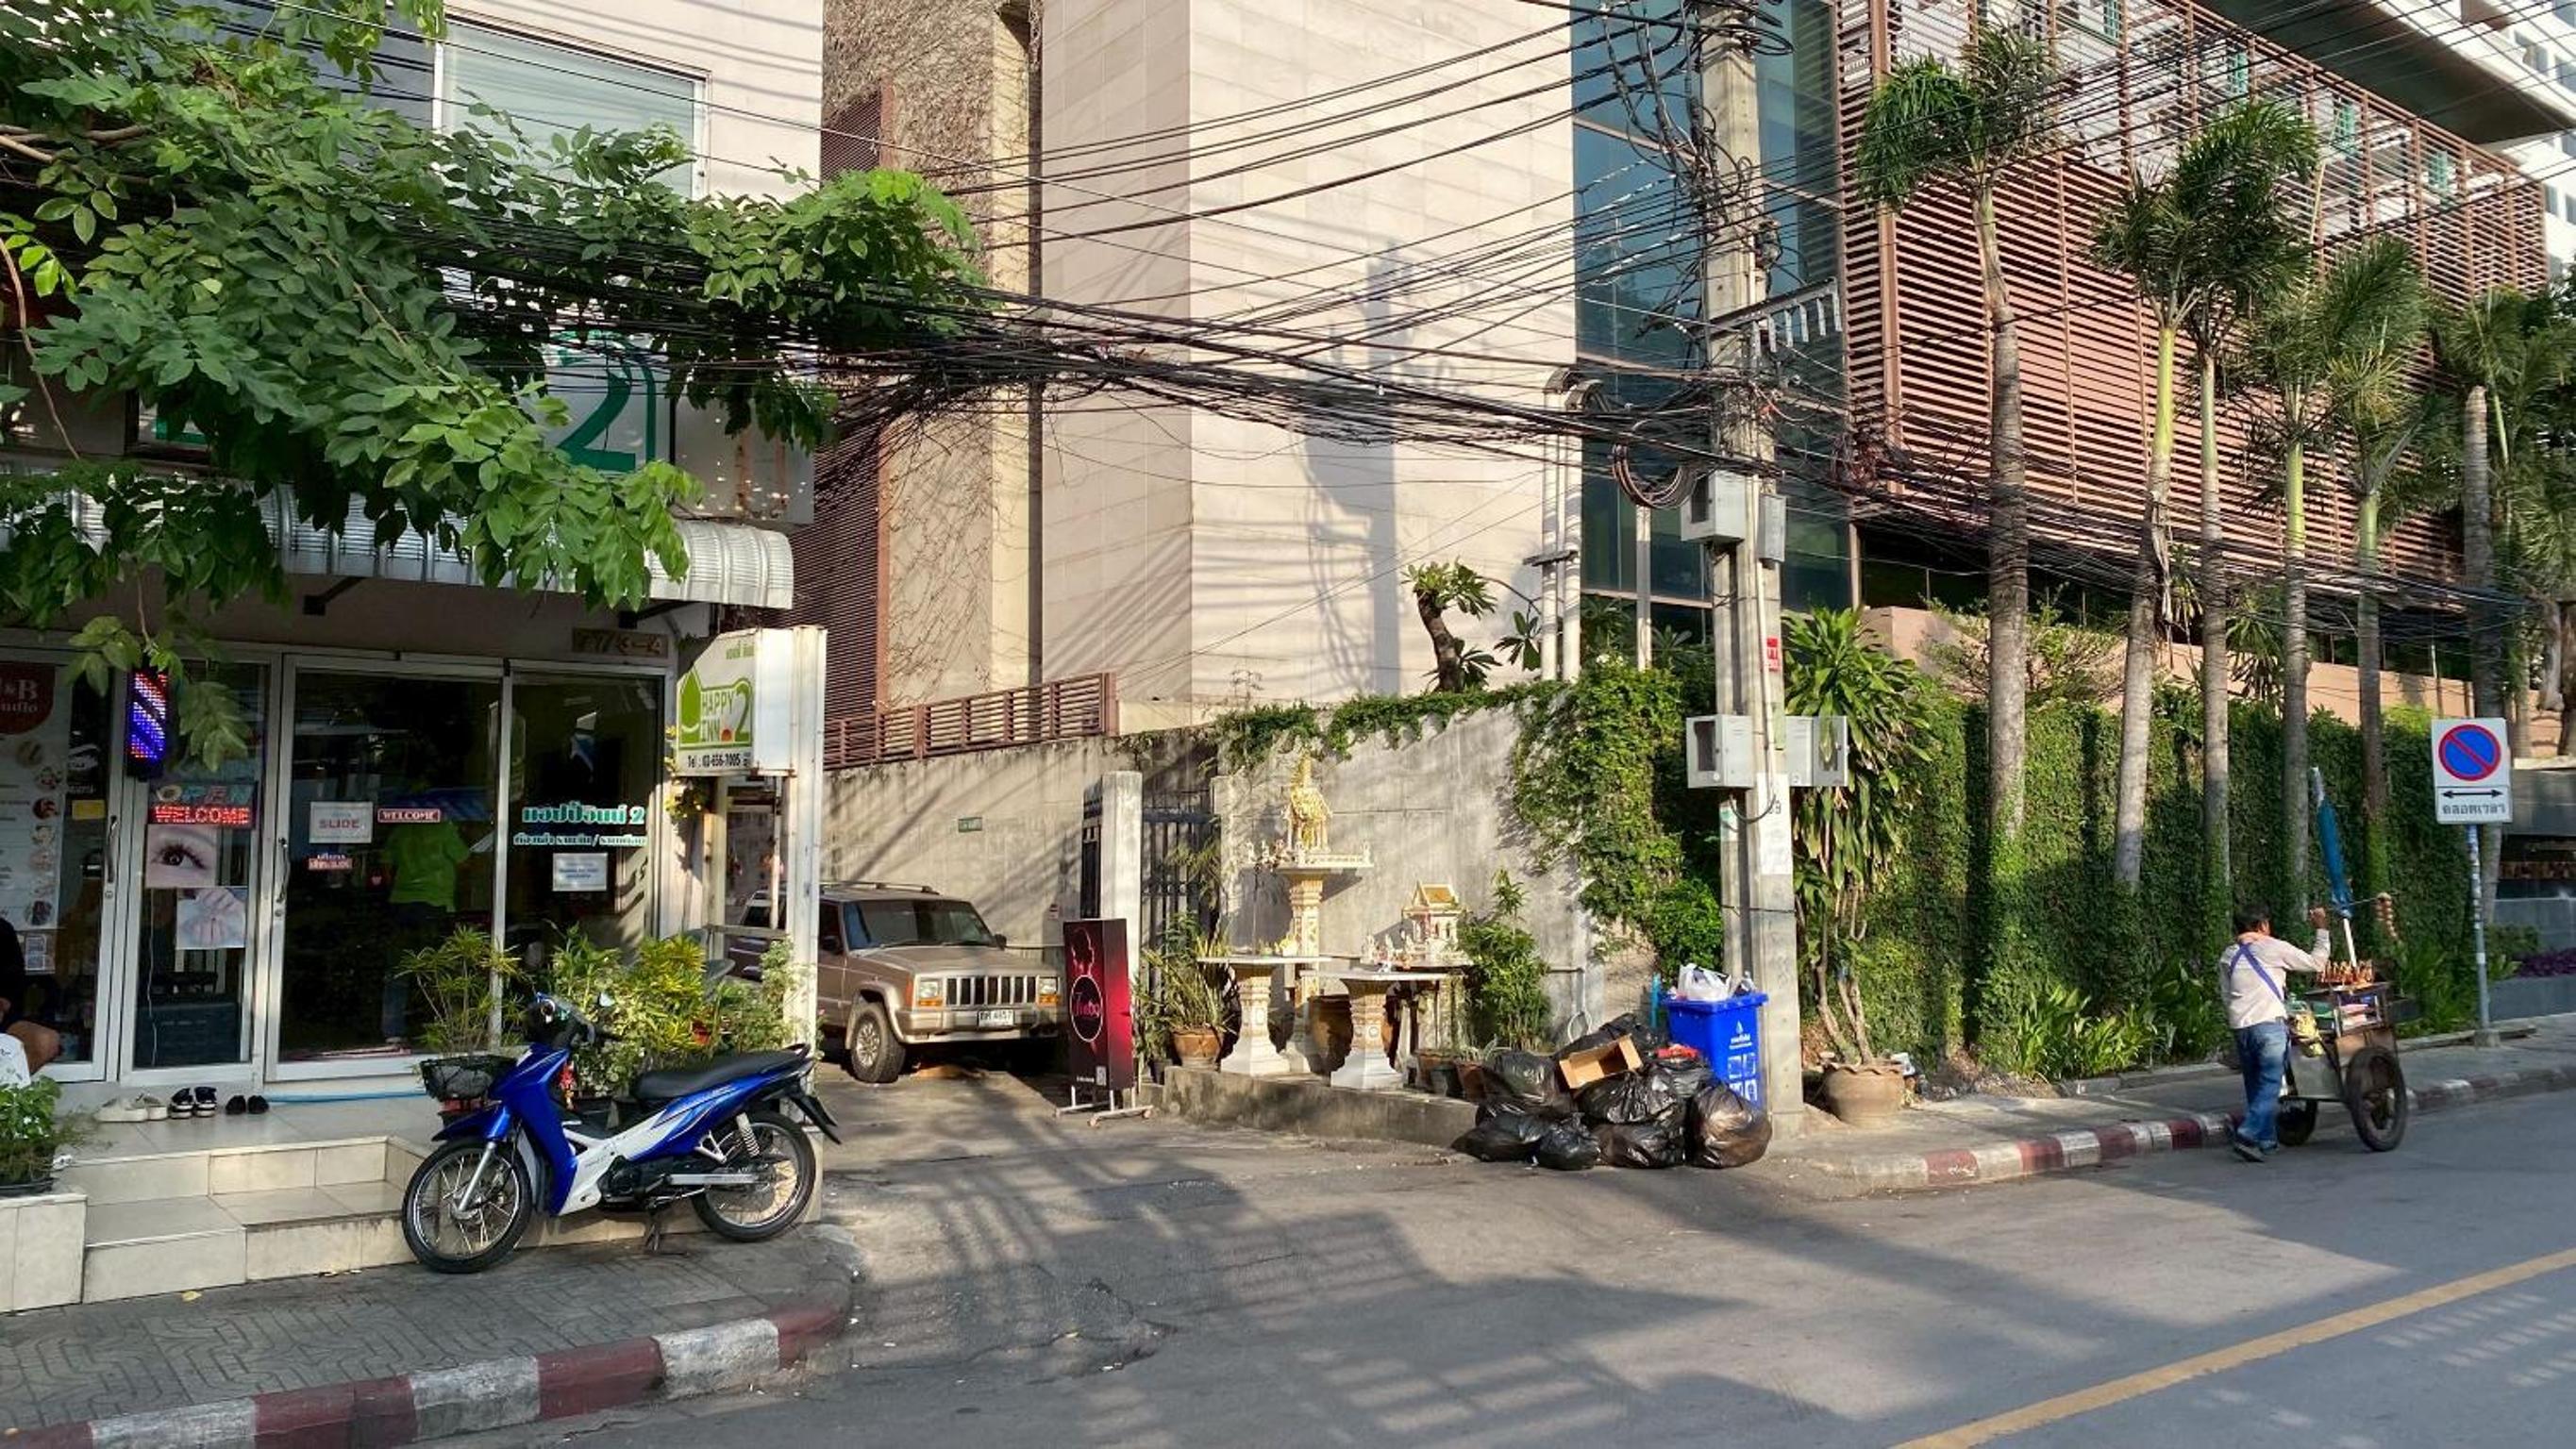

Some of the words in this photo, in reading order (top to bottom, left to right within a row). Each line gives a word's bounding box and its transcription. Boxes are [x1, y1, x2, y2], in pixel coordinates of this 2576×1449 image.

[155, 806, 250, 824] WELCOME
[382, 810, 434, 821] WELCOME
[319, 818, 360, 829] SLIDE
